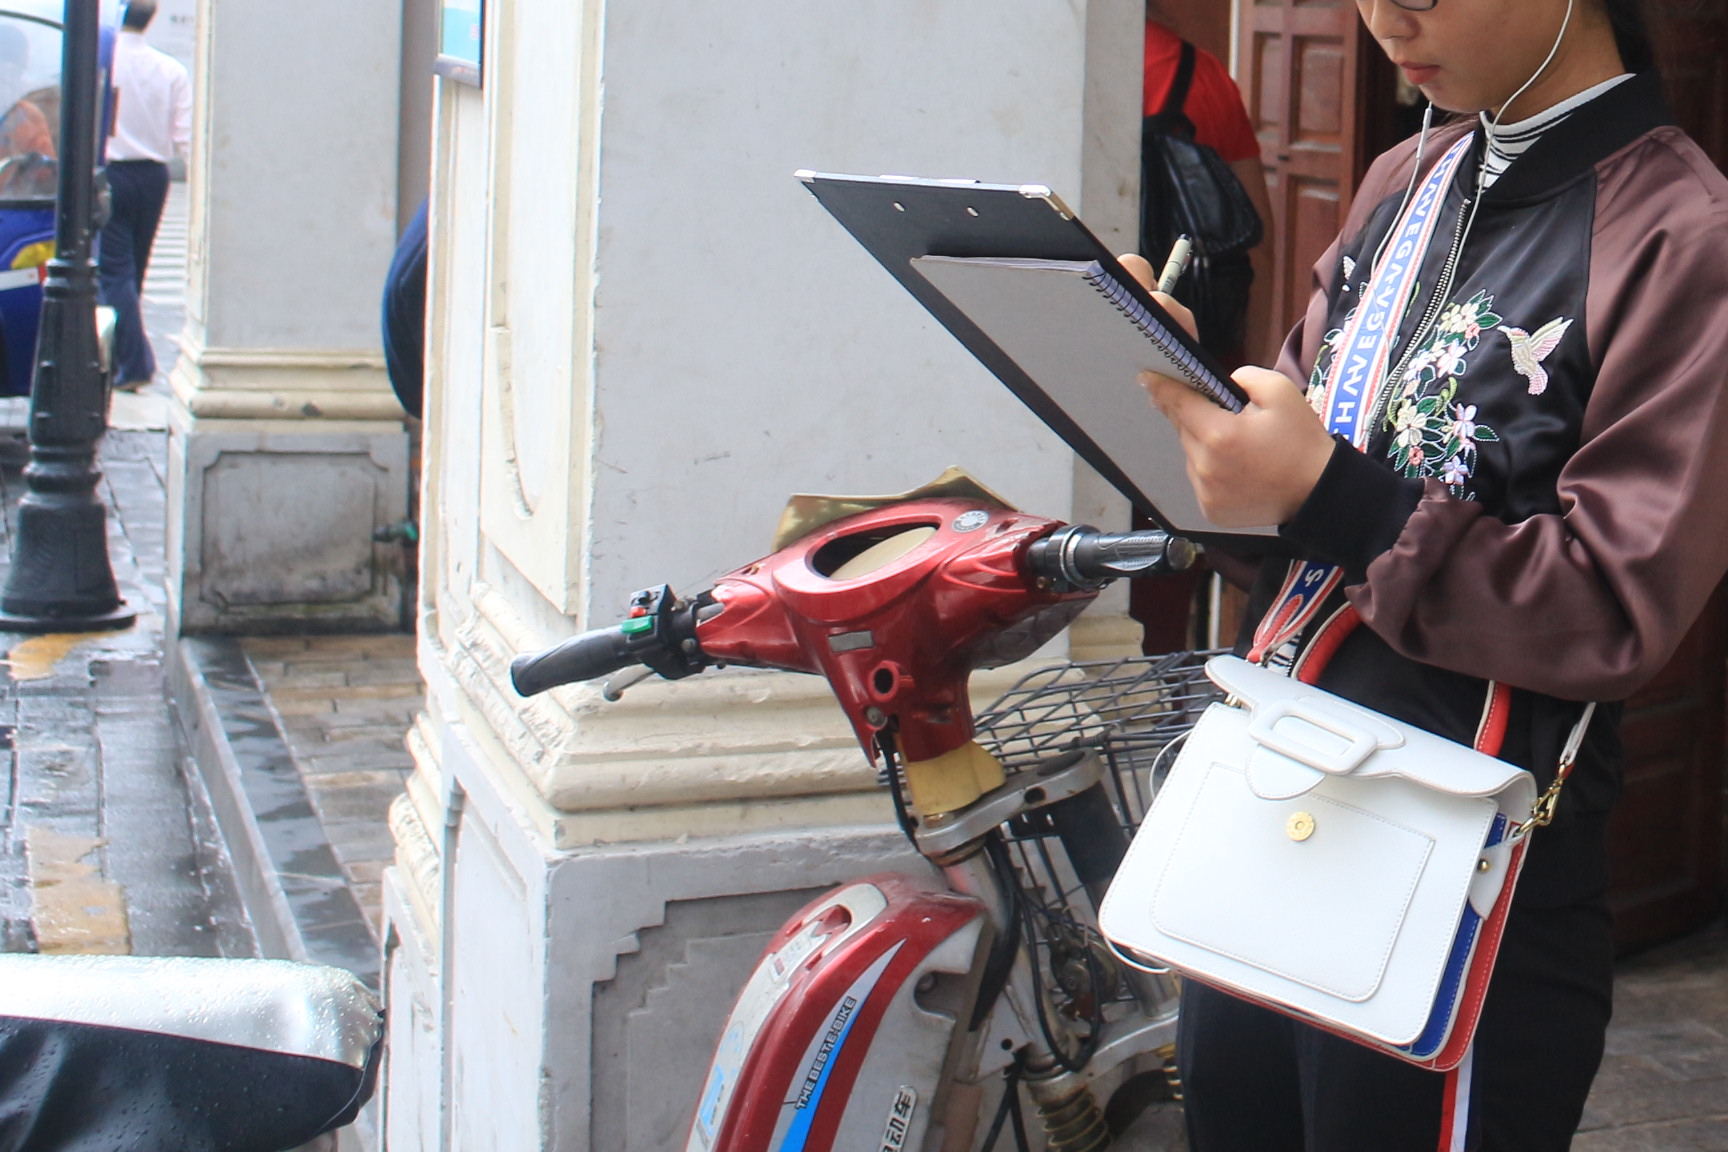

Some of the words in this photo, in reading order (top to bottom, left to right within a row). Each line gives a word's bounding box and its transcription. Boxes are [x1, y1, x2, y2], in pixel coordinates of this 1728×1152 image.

[795, 1079, 814, 1110] THE
[808, 1039, 836, 1081] BEST
[879, 1091, 914, 1152] 动车
